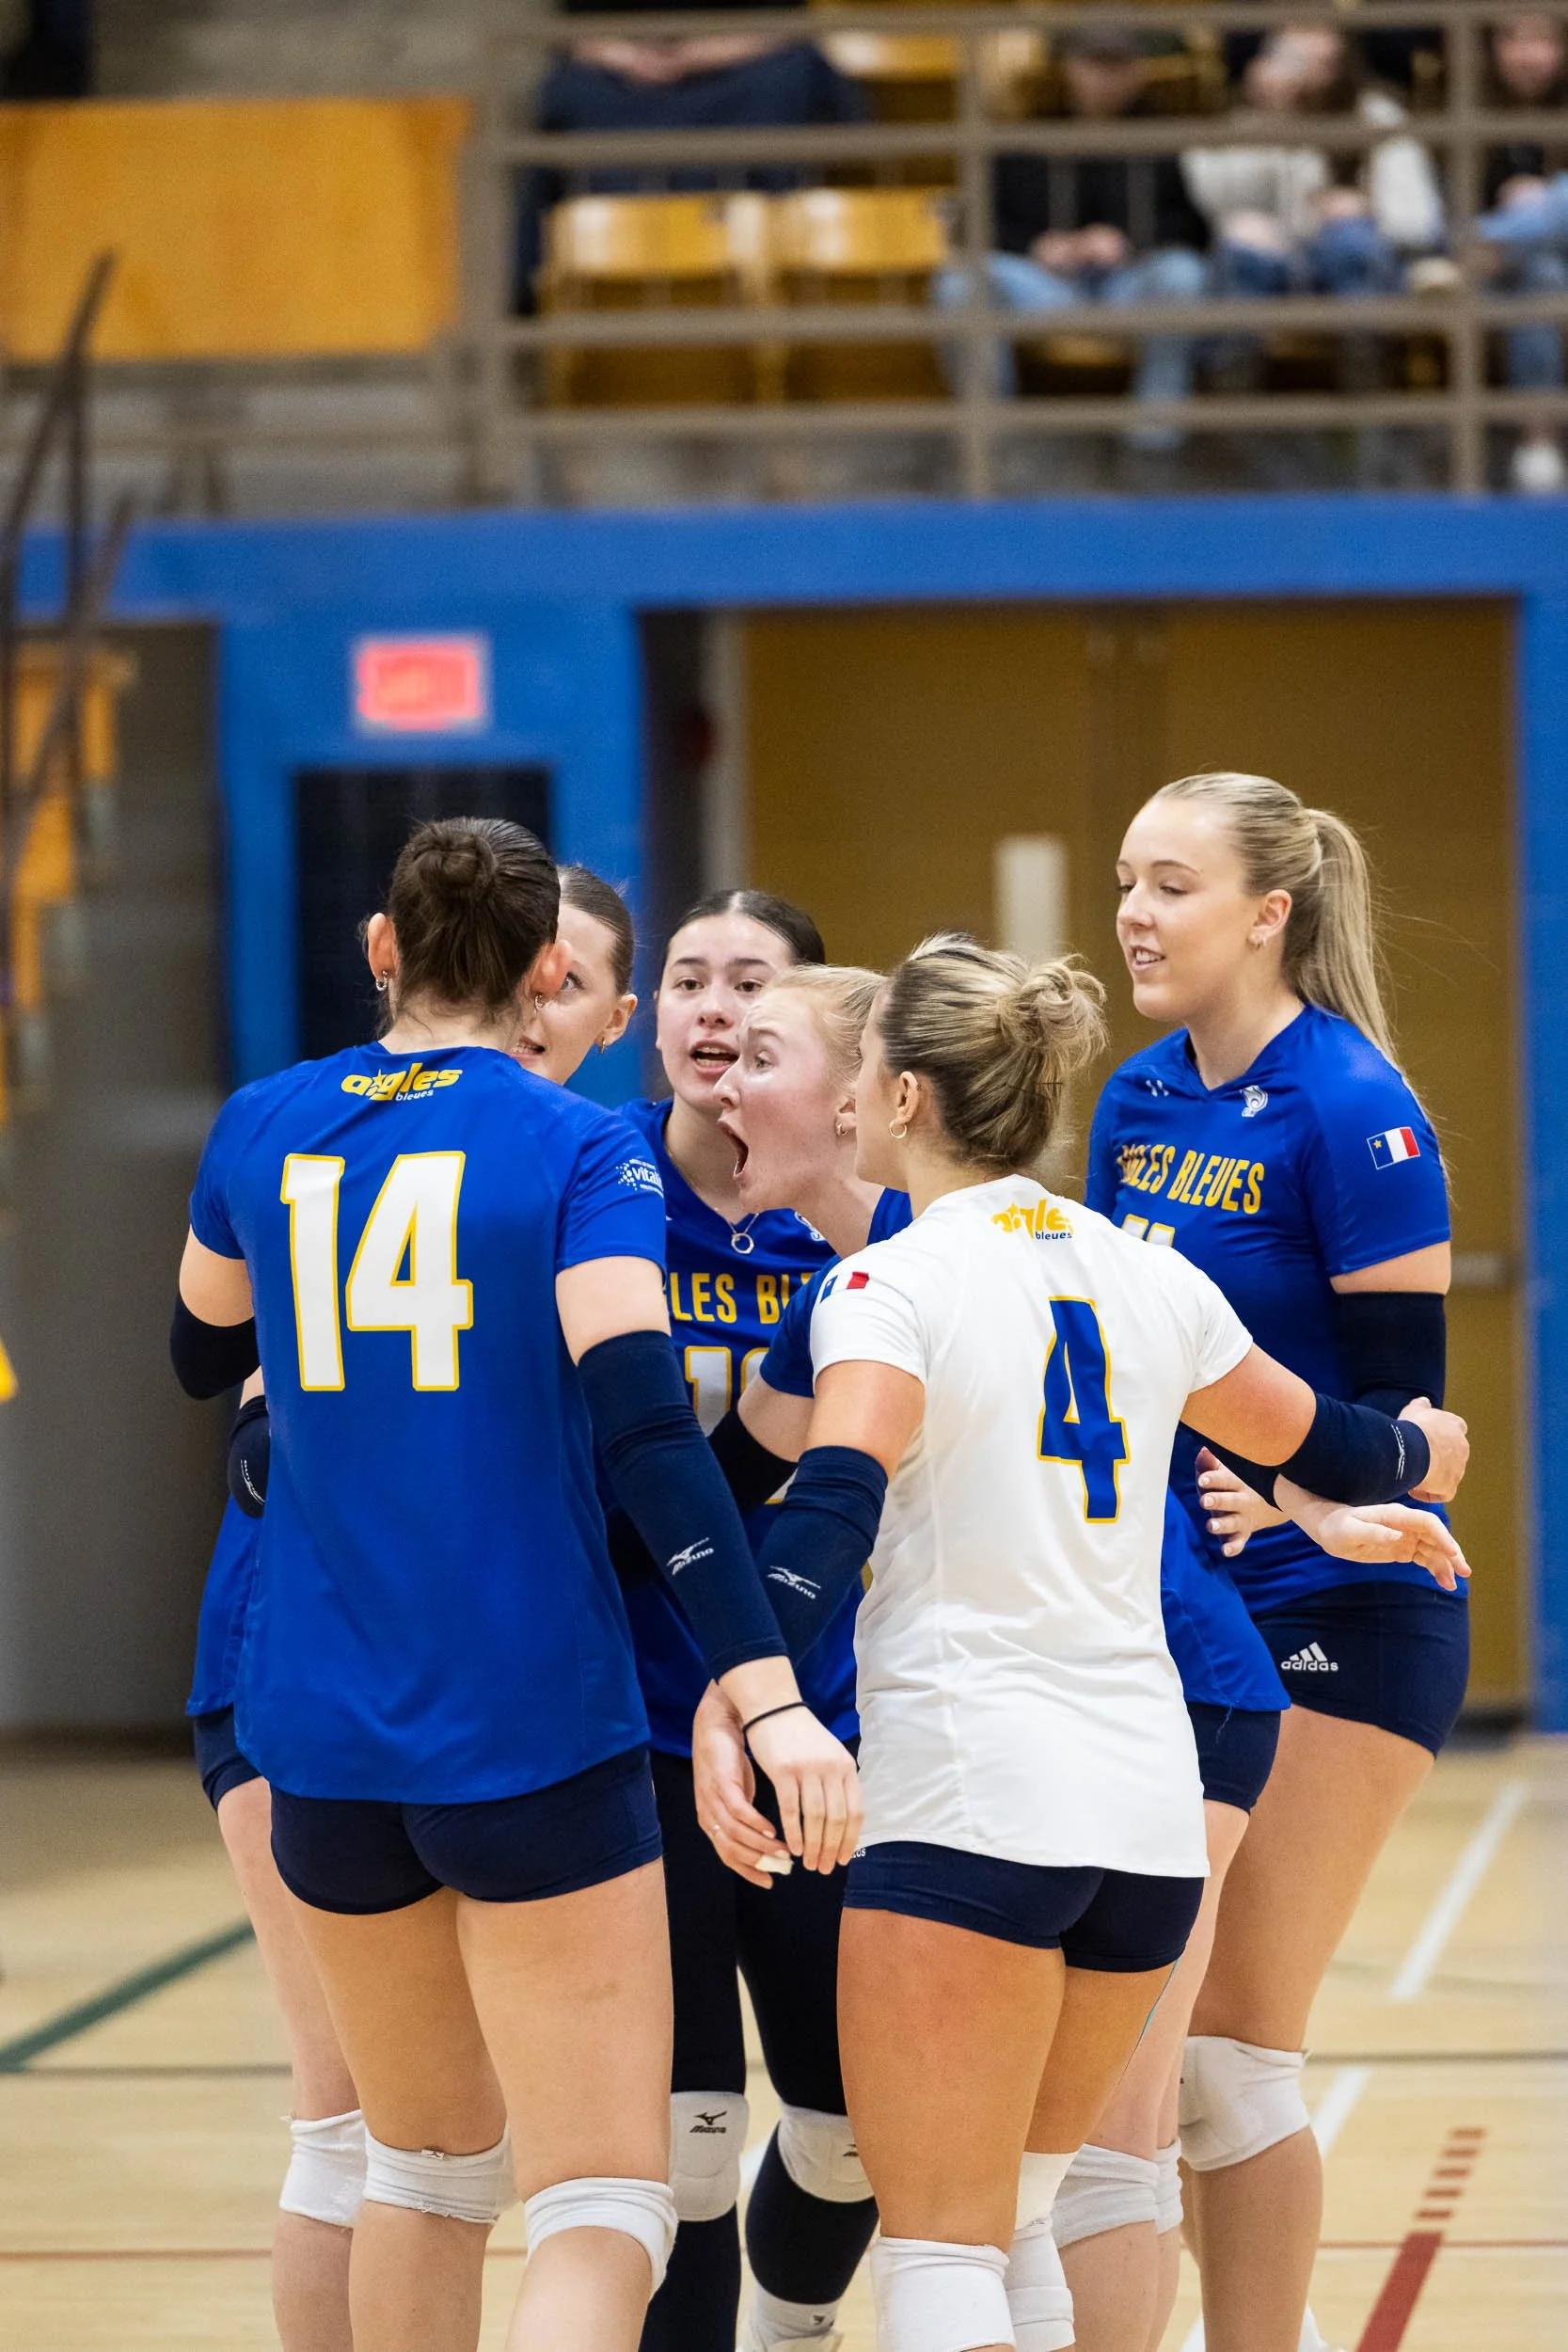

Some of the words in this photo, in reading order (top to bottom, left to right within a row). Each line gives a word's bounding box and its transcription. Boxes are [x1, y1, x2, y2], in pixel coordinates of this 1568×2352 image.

[341, 1062, 463, 1101] aigles
[395, 1089, 434, 1102] bleues
[1166, 1150, 1265, 1215] BLEUES
[280, 1151, 474, 1391] 14
[662, 1272, 737, 1324] LES
[1037, 1295, 1131, 1524] 4
[1280, 1659, 1339, 1672] adidas
